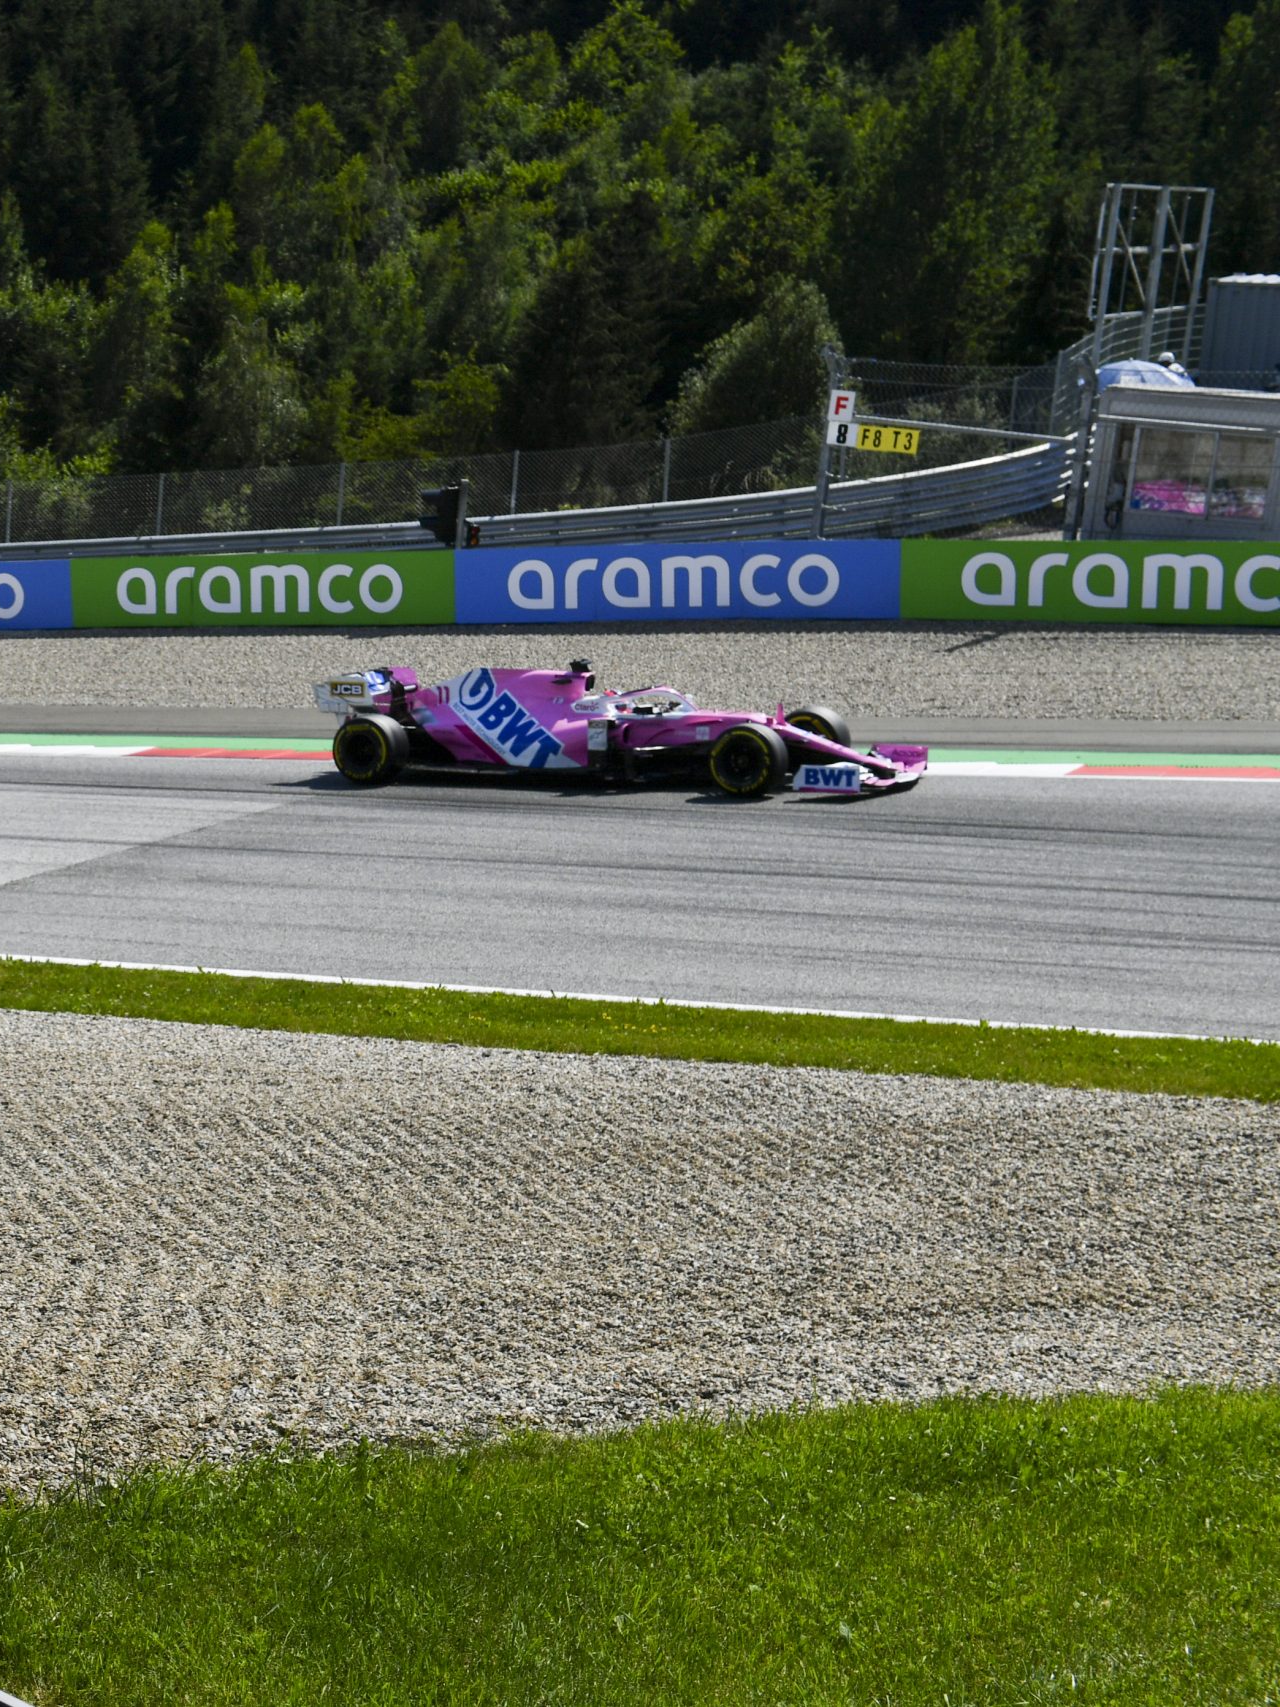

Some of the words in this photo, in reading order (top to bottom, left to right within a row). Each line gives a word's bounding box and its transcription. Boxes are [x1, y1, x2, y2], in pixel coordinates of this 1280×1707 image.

[834, 396, 849, 415] F
[836, 424, 849, 444] 8
[861, 428, 882, 448] F8
[892, 430, 913, 451] T3
[117, 564, 404, 614] aramco
[507, 553, 841, 610] aramco
[961, 552, 1280, 612] aramc
[332, 684, 363, 695] JCB
[574, 703, 597, 712] Claro
[477, 691, 563, 768] BWT
[804, 768, 856, 788] BWT
